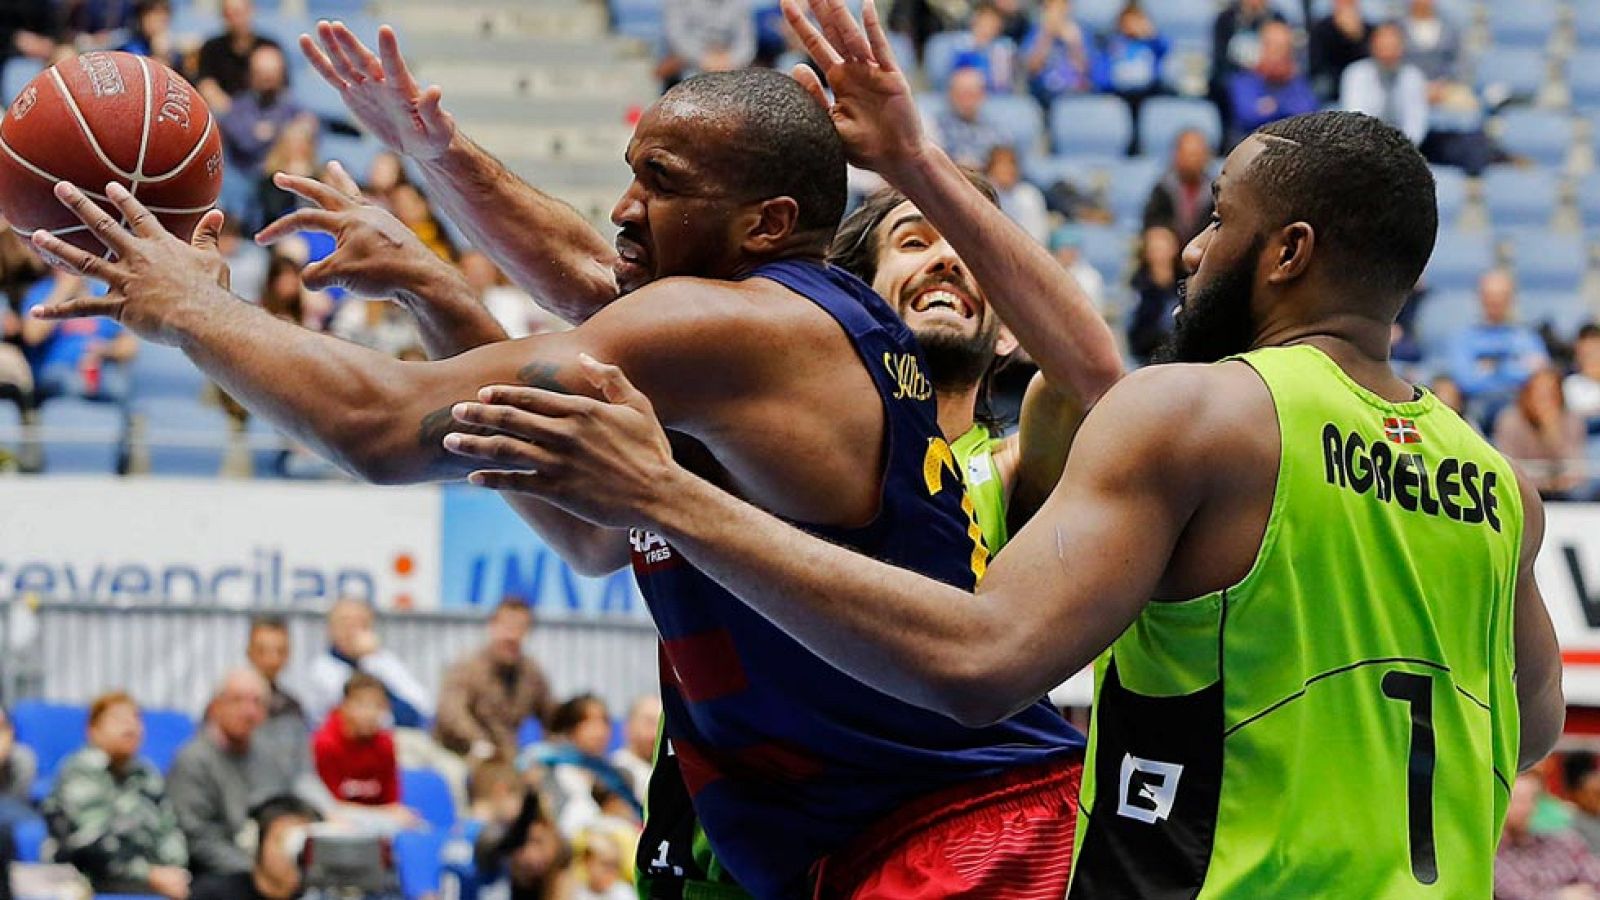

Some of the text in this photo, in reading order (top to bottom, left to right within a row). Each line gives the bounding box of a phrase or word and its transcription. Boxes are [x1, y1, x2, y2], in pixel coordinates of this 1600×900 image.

[1322, 421, 1501, 533] AGRELESE
[0, 550, 375, 602] evencilan
[1380, 670, 1438, 885] 1
